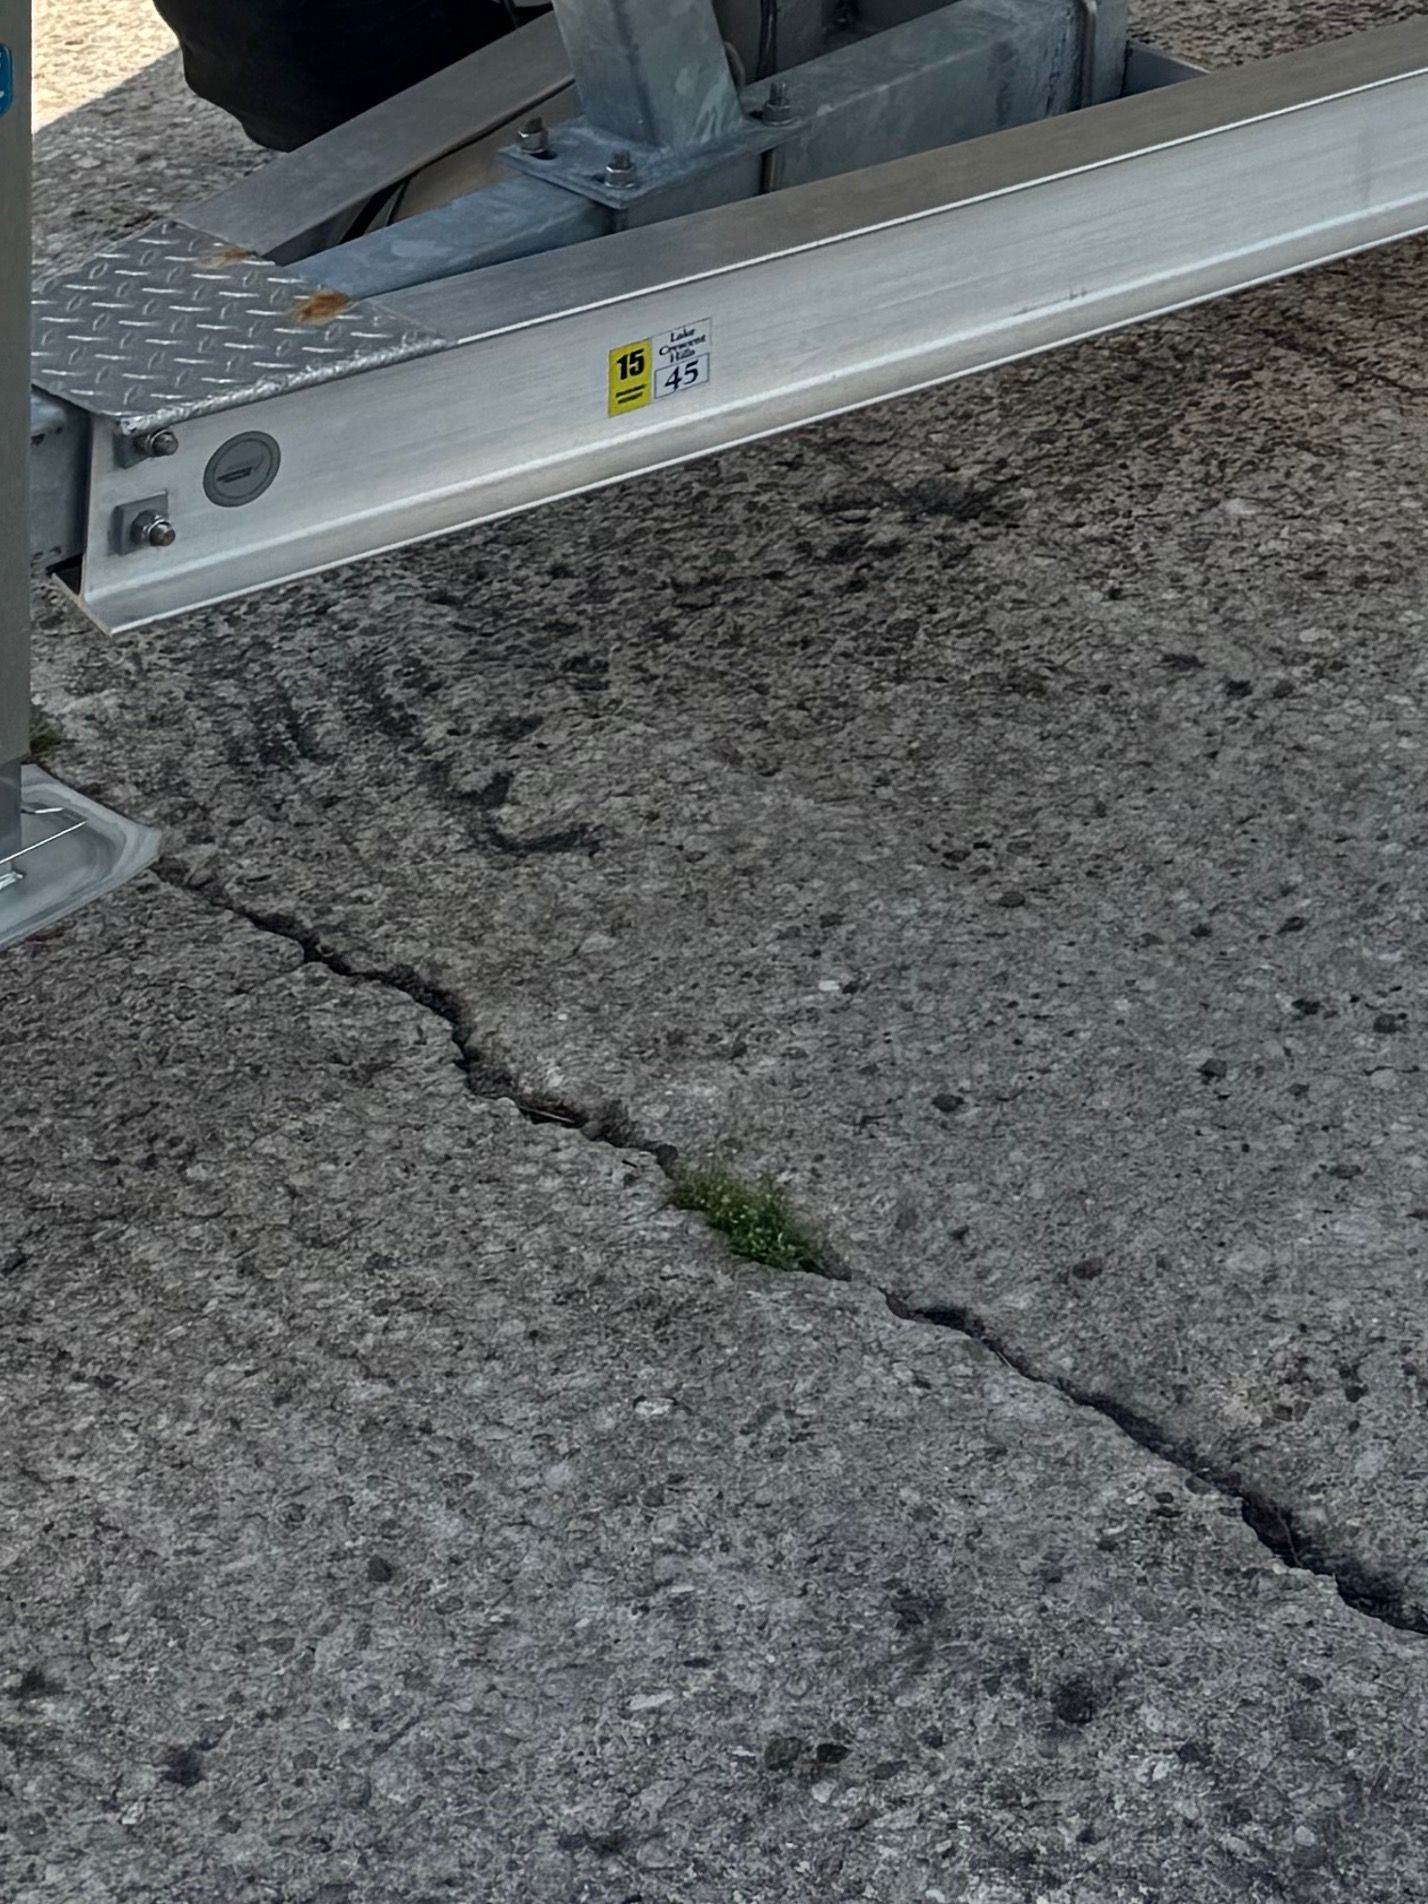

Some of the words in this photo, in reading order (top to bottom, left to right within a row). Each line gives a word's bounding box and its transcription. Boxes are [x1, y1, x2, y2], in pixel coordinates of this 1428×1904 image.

[670, 326, 696, 343] Lake
[616, 348, 645, 381] 15
[664, 358, 699, 392] 45
